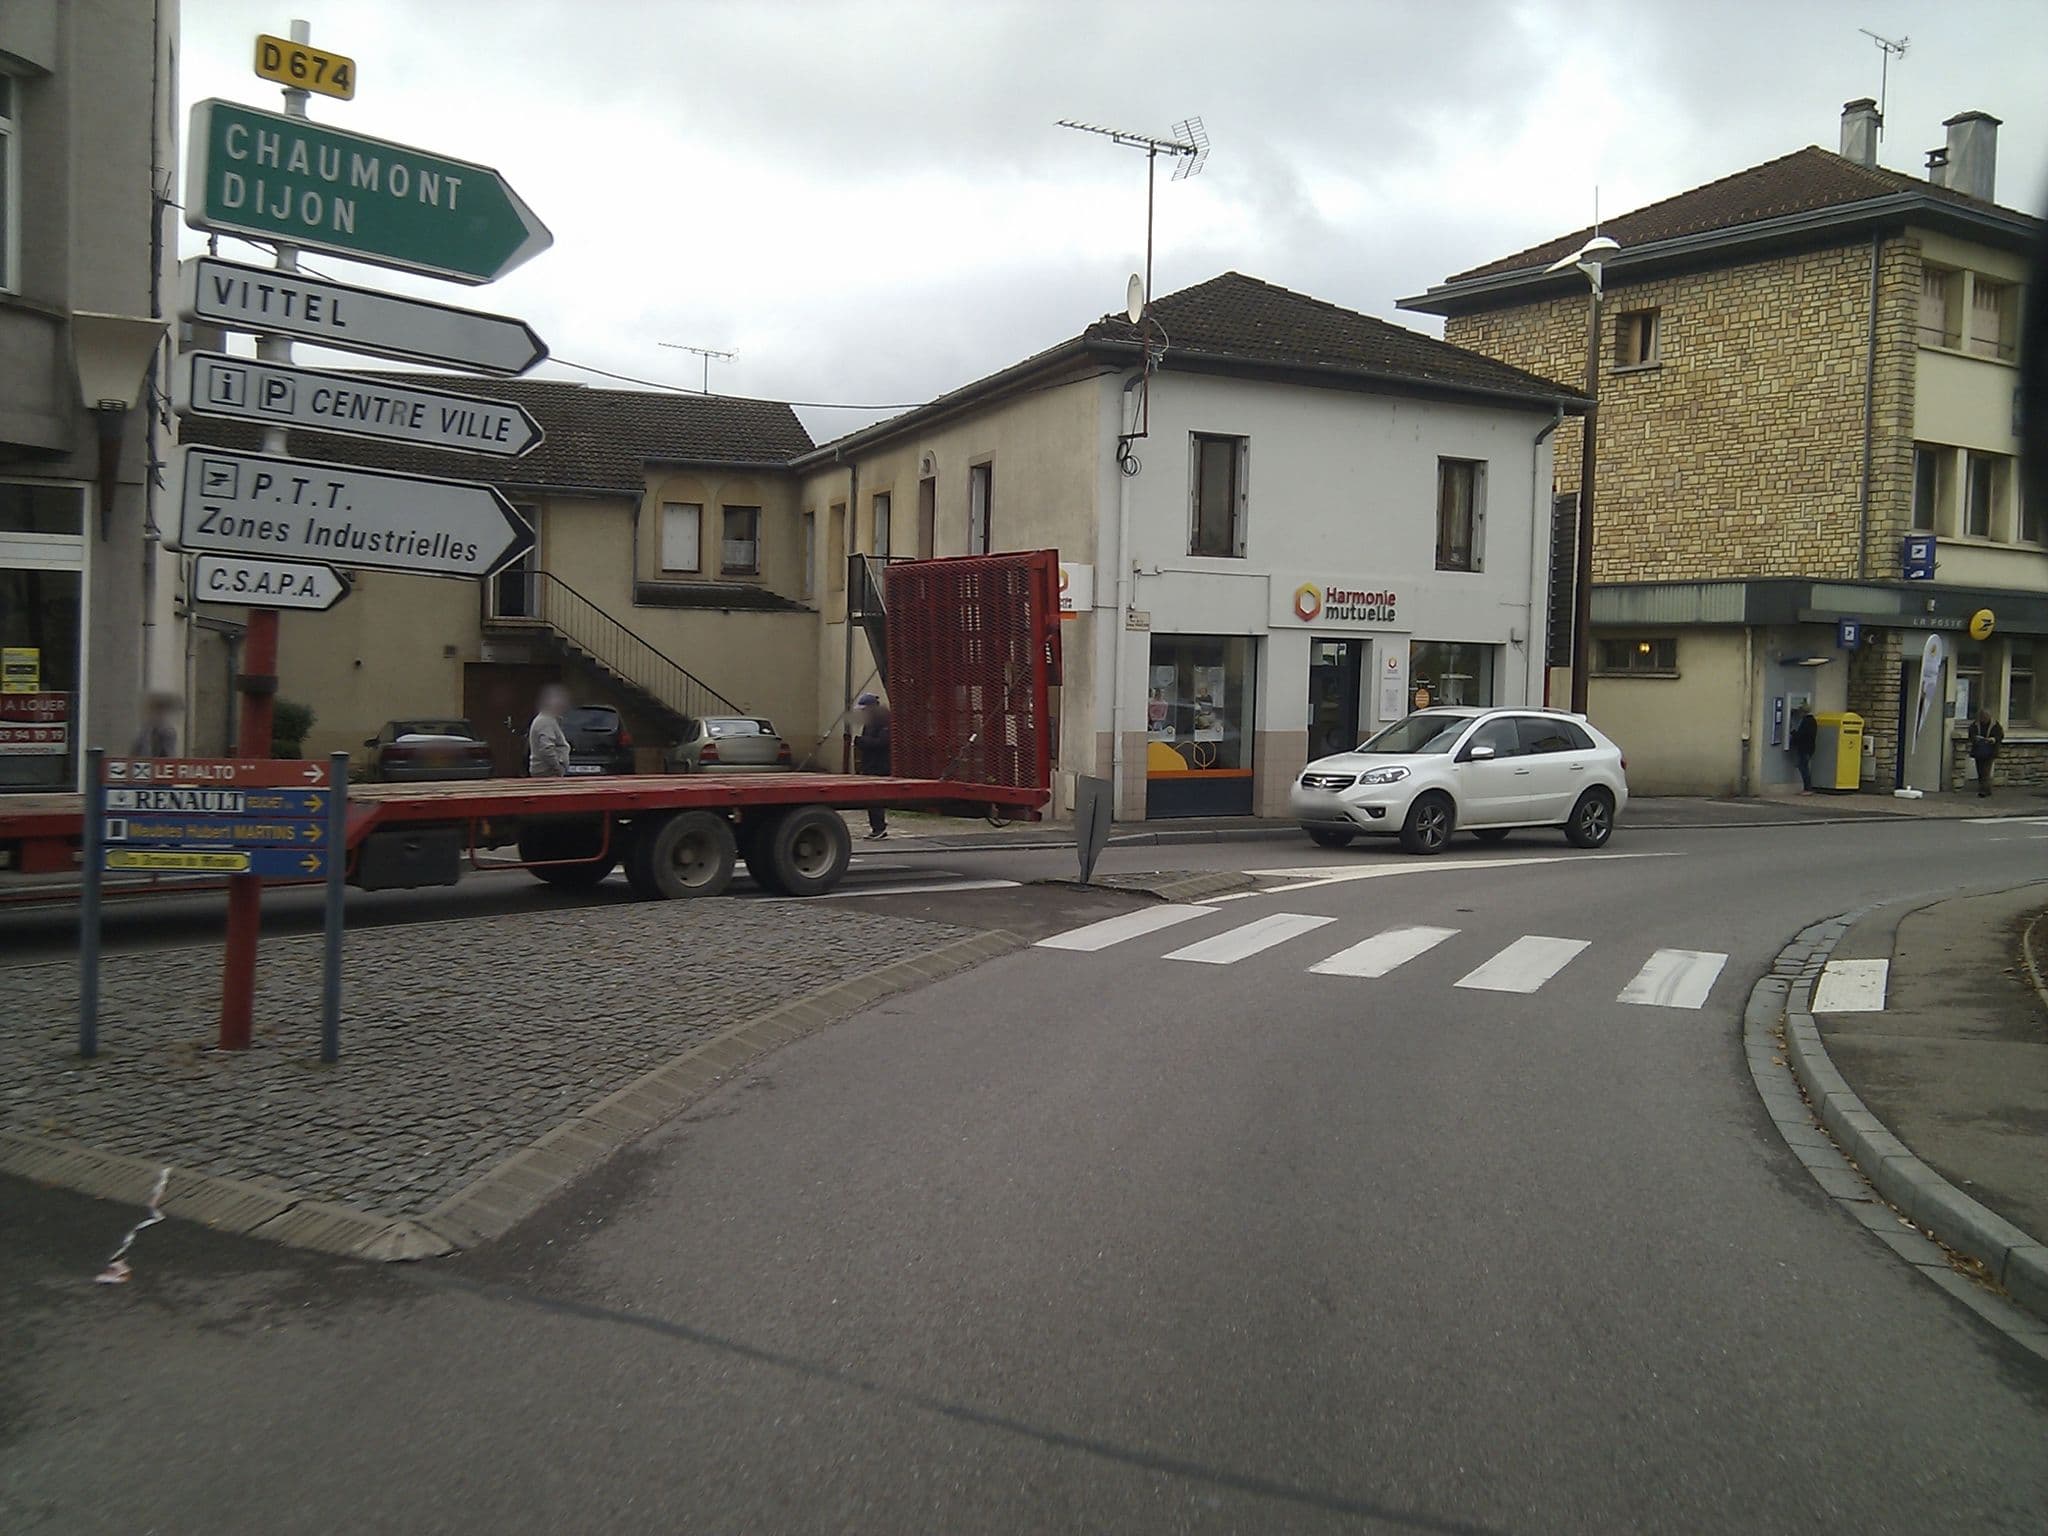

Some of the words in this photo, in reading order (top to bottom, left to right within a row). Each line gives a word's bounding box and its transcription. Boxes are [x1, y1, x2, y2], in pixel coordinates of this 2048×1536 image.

[263, 42, 281, 72] D
[289, 51, 350, 91] 674
[224, 122, 463, 211] CHAUMONT
[222, 171, 356, 235] DIJON
[212, 275, 347, 328] VITTEL
[311, 387, 425, 429] CENTRE
[441, 407, 512, 443] VILLE
[251, 472, 352, 511] P.T.T.
[197, 504, 290, 543] Zones
[303, 517, 479, 563] Industrielles
[208, 567, 321, 598] C.S.A.P.A.
[1326, 587, 1397, 606] Harmonie
[1325, 603, 1396, 621] mutuelle
[20, 699, 65, 711] LOUER
[155, 764, 175, 779] LE
[179, 764, 236, 780] RIALTO
[135, 790, 243, 811] RENAULT
